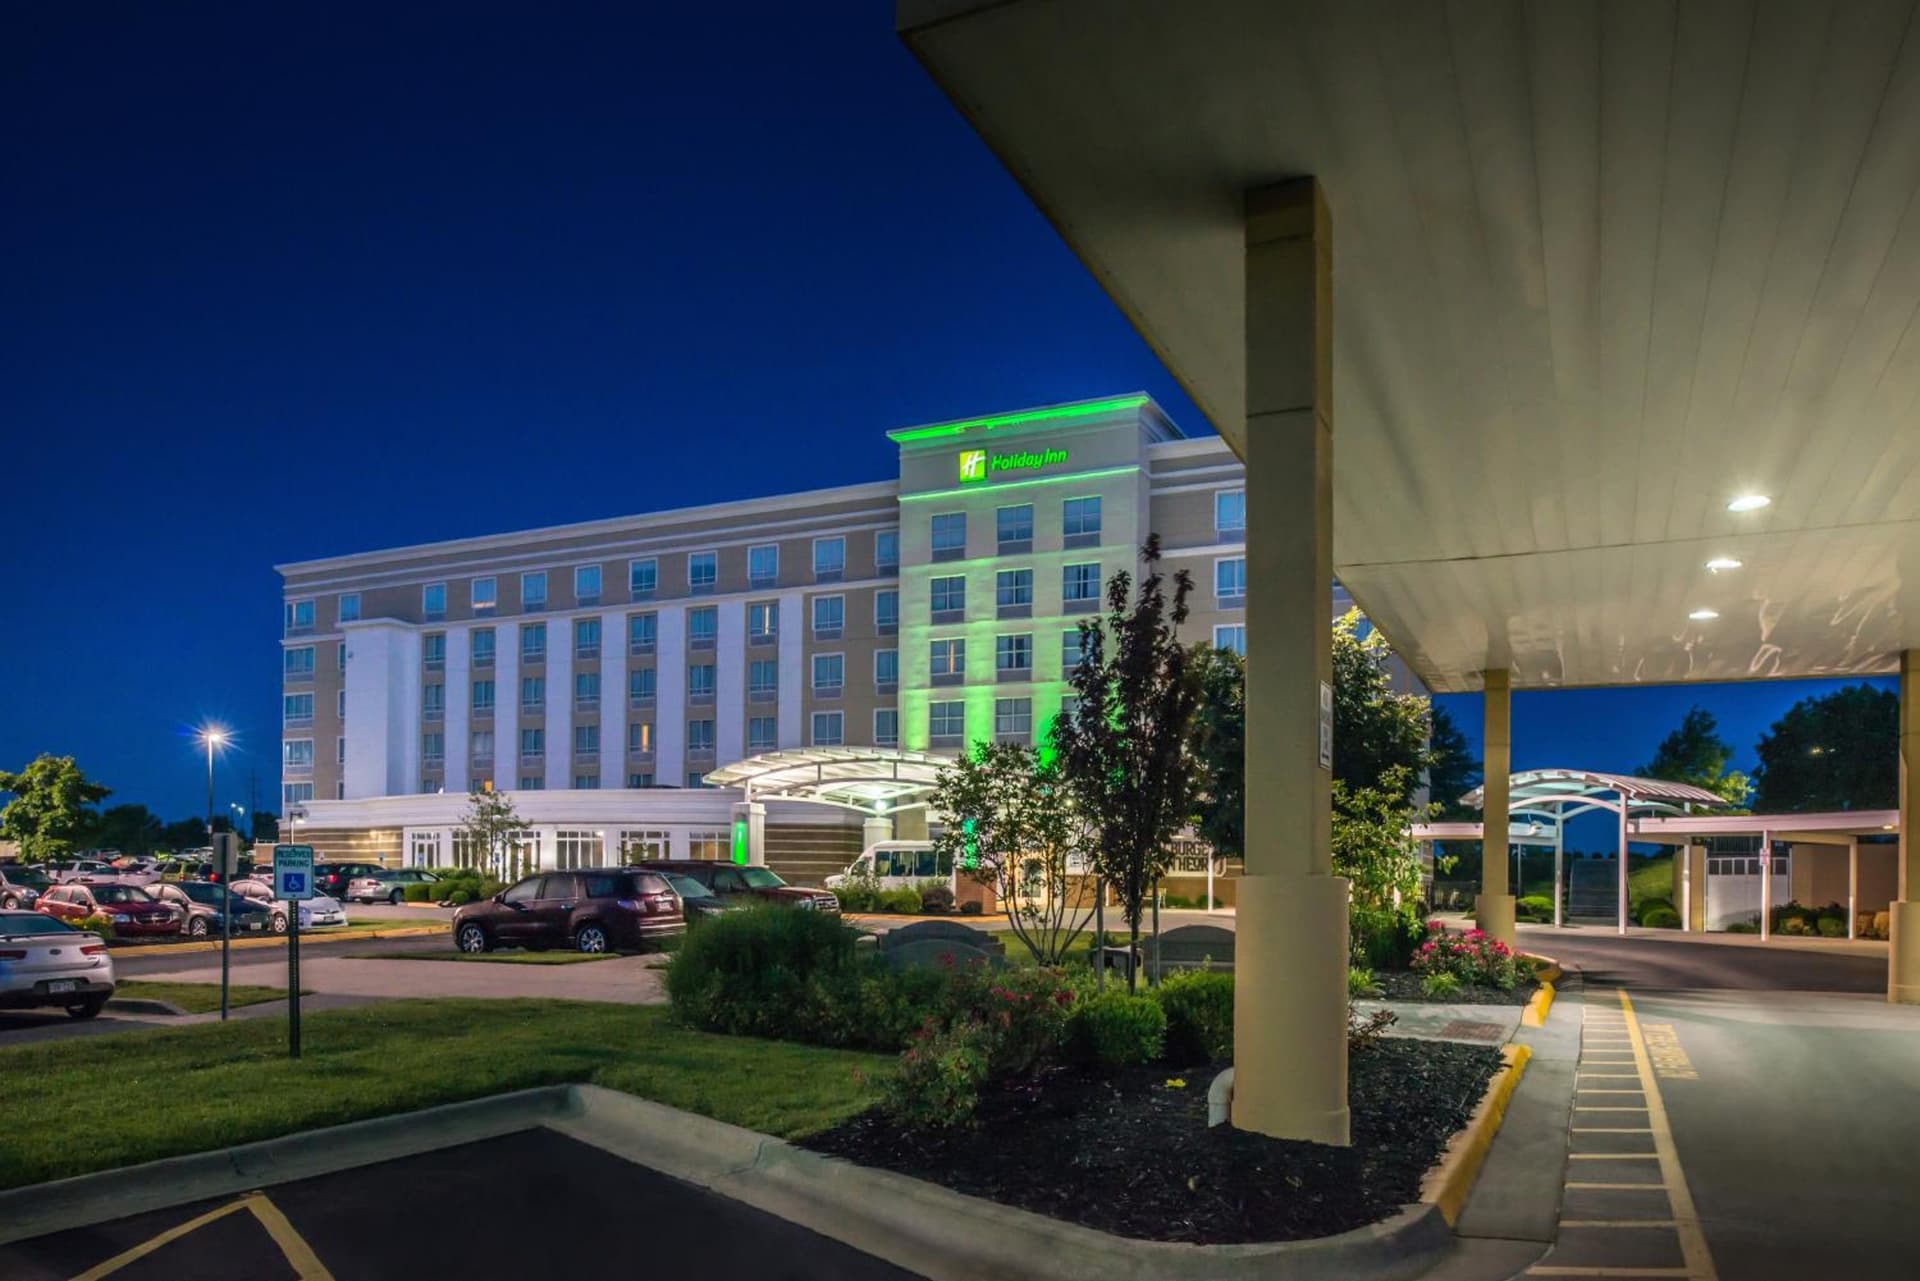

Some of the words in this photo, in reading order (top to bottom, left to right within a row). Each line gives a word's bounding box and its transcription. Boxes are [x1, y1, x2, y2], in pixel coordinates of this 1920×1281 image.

[991, 451, 1043, 470] Holiday
[1045, 448, 1067, 464] Inn
[278, 850, 311, 858] RESERVED
[1171, 841, 1210, 856] BURGE
[278, 859, 310, 868] PARKING
[1171, 856, 1210, 871] THEOR
